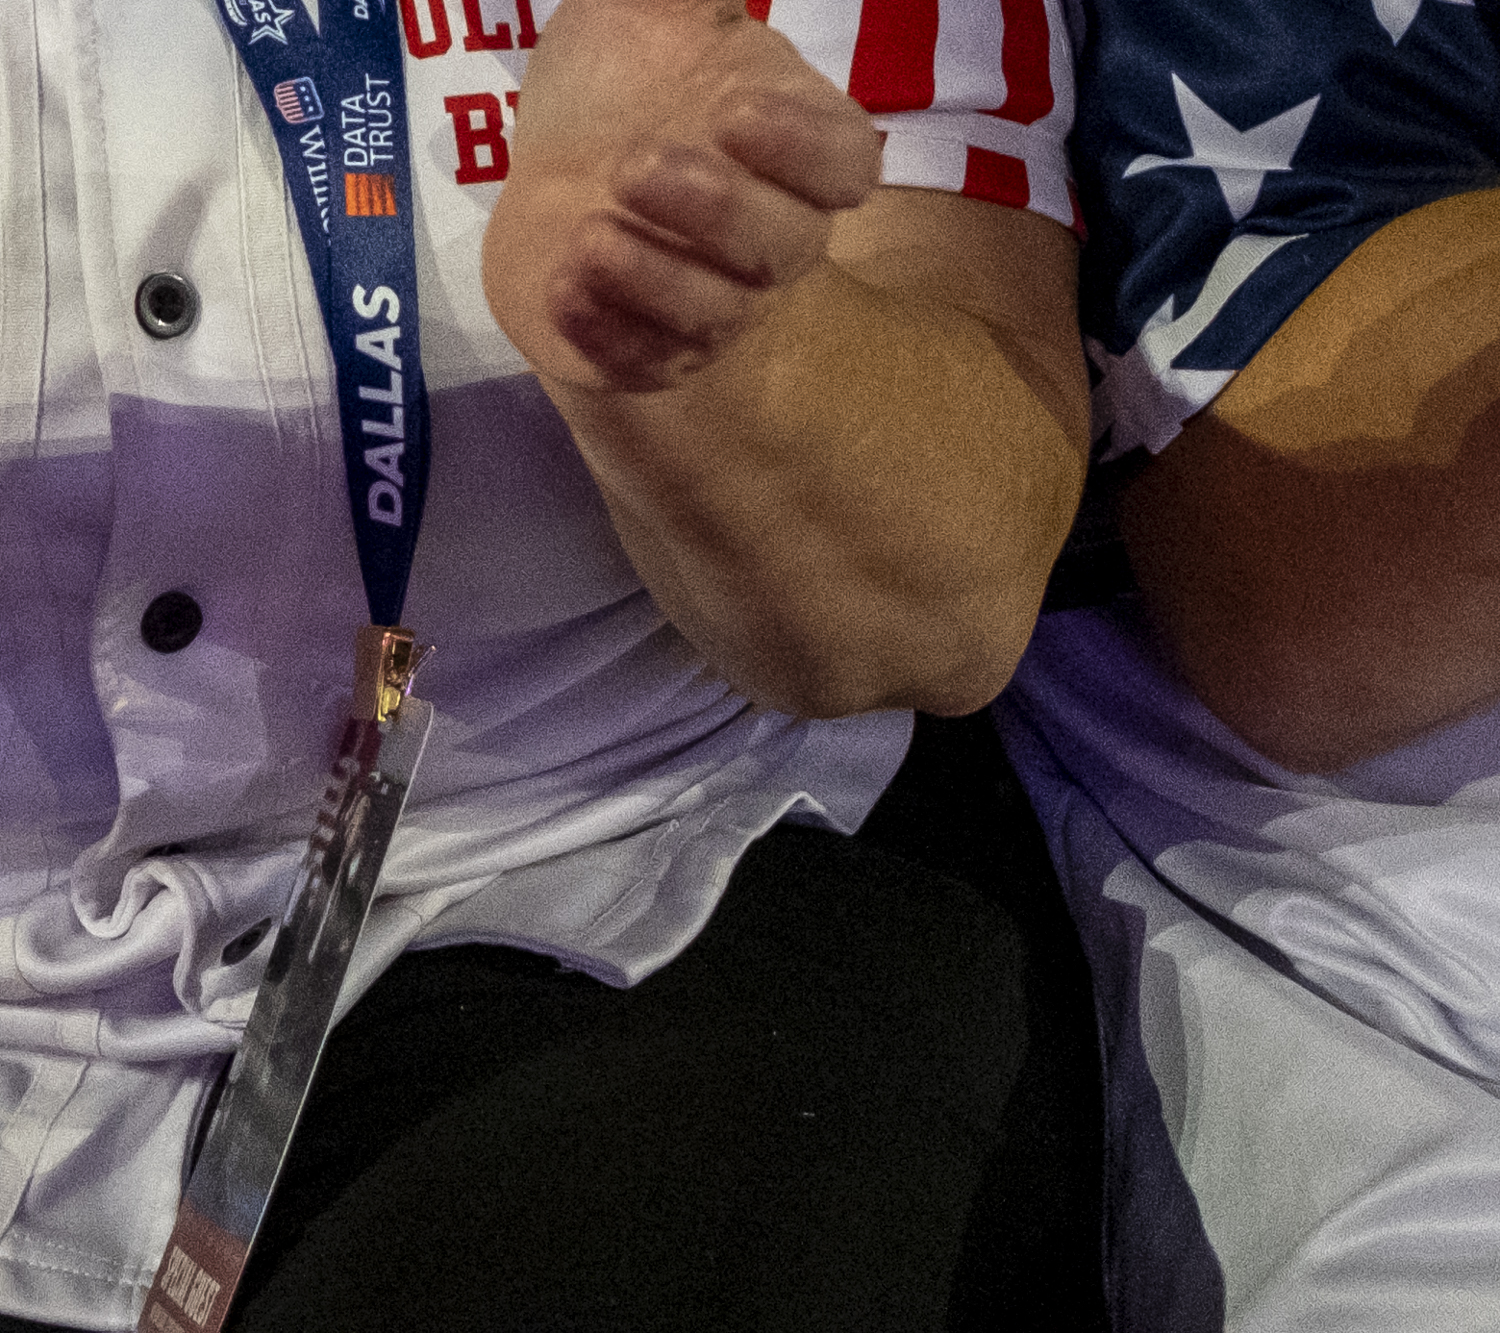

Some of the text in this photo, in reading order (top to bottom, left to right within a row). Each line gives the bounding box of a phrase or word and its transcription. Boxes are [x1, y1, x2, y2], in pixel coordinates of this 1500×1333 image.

[341, 94, 368, 166] DATA
[365, 73, 394, 166] TRUST
[353, 283, 405, 527] DALLAS
